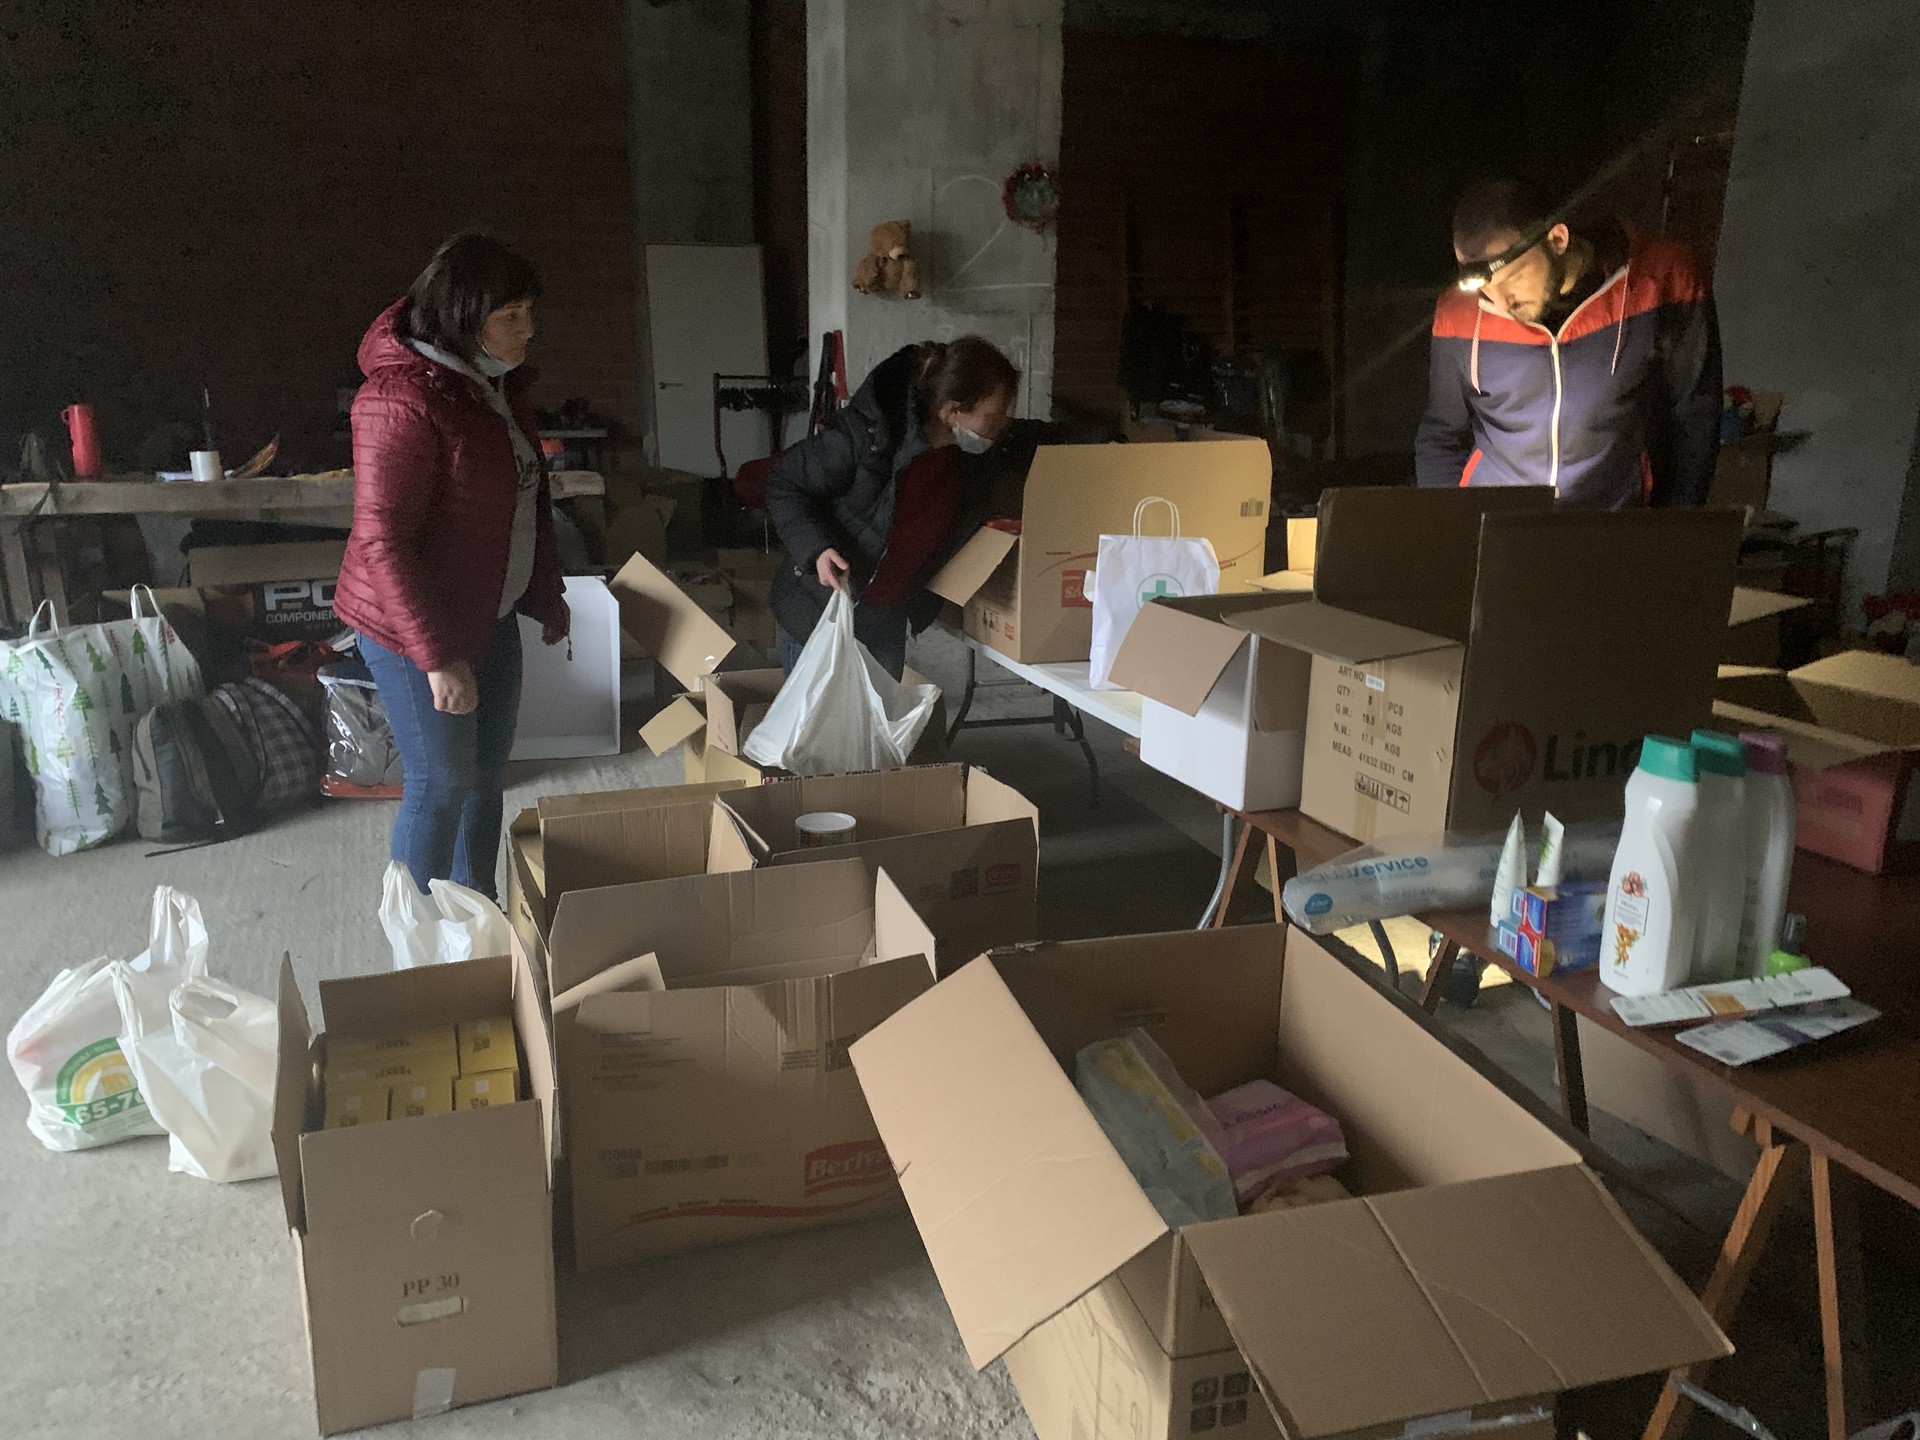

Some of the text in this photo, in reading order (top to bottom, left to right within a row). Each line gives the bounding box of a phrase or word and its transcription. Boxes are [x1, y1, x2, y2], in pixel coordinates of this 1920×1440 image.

[265, 609, 338, 623] COMPONEN
[1338, 665, 1352, 678] ART
[1387, 701, 1404, 717] PCS
[1385, 722, 1403, 737] KGS
[1384, 742, 1401, 757] KGS
[1402, 769, 1414, 783] CM
[403, 1273, 460, 1297] PP 30
